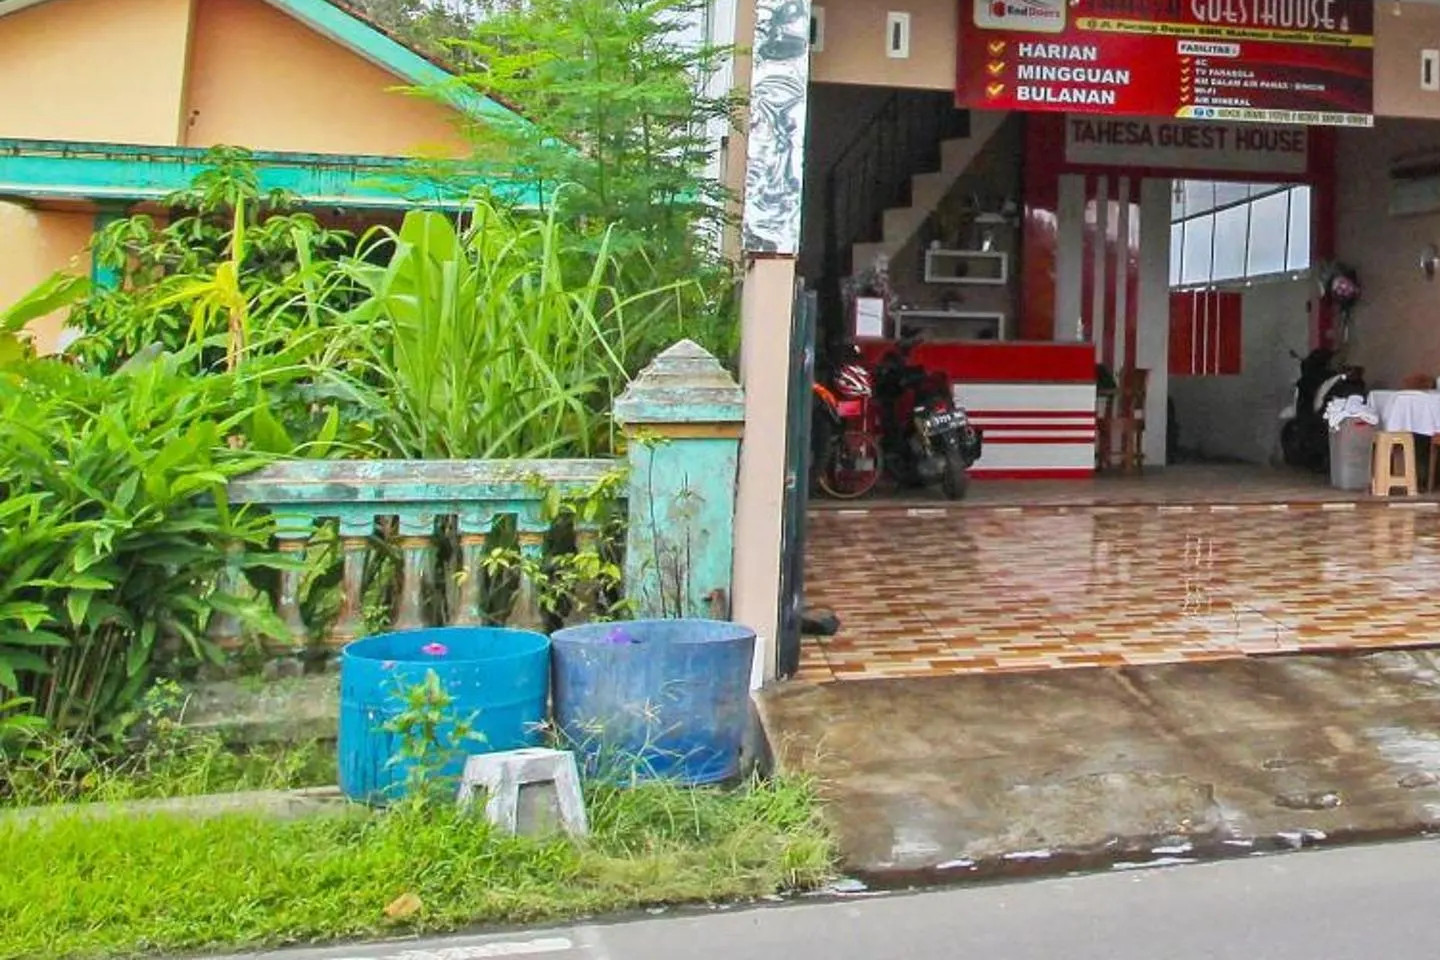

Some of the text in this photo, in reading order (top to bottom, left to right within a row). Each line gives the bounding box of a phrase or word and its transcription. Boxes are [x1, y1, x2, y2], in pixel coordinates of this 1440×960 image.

[1018, 43, 1097, 60] HARIAN
[1181, 44, 1230, 54] FASILITAS
[1017, 64, 1130, 85] MINGGUAN
[1195, 68, 1255, 78] TV PARABOLA
[1211, 78, 1240, 87] DALAM
[1243, 80, 1258, 88] AIR
[1016, 85, 1116, 105] BULANAN
[1211, 97, 1251, 106] MINERAL
[1072, 120, 1305, 153] TAHESA GUEST HOUSE
